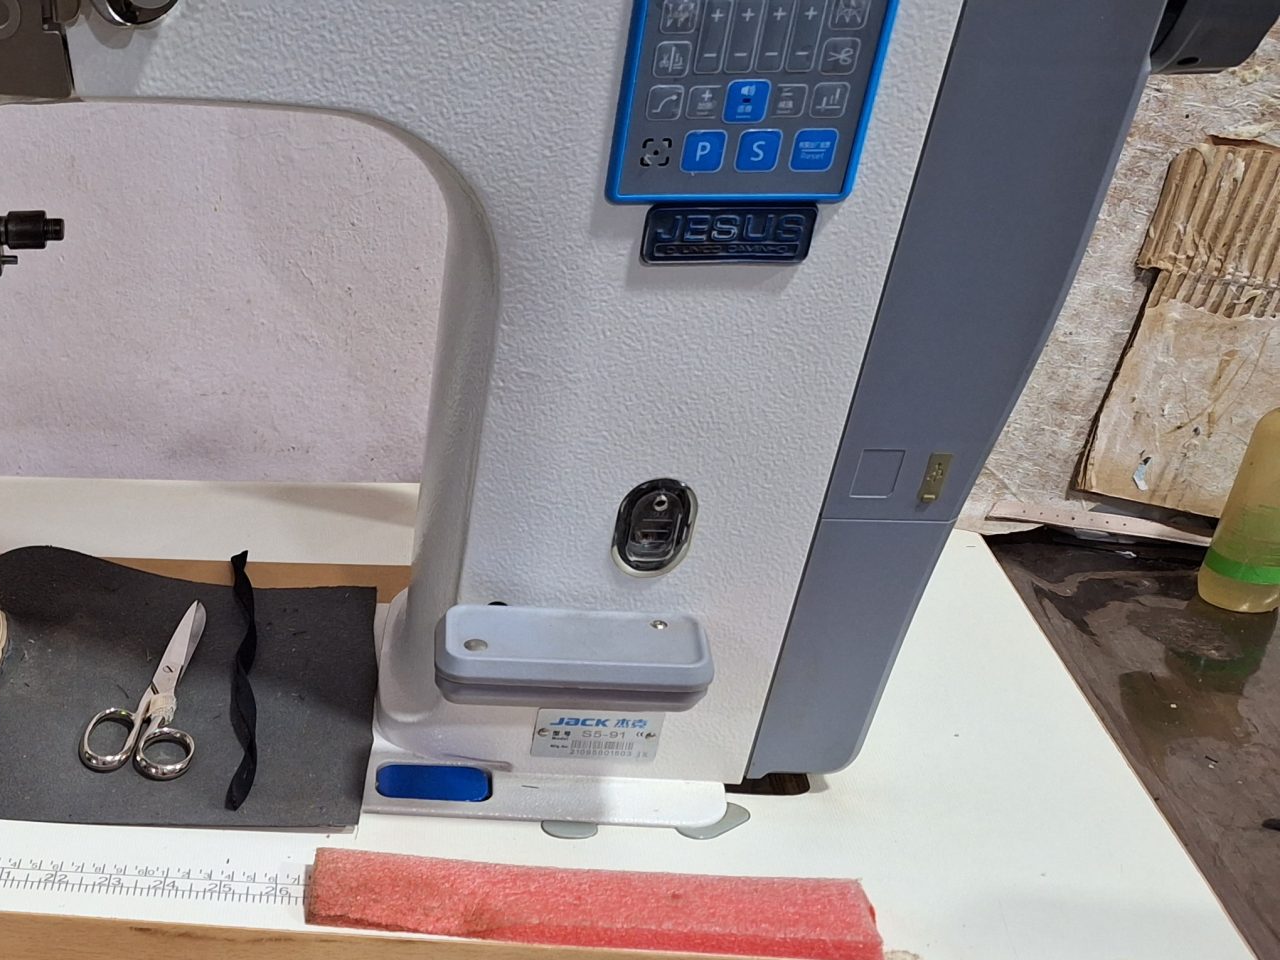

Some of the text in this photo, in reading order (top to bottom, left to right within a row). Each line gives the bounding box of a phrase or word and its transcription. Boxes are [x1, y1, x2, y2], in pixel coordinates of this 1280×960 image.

[696, 142, 711, 162] P
[750, 141, 766, 161] S
[655, 214, 805, 242] JESUS
[581, 730, 625, 738] S5-91
